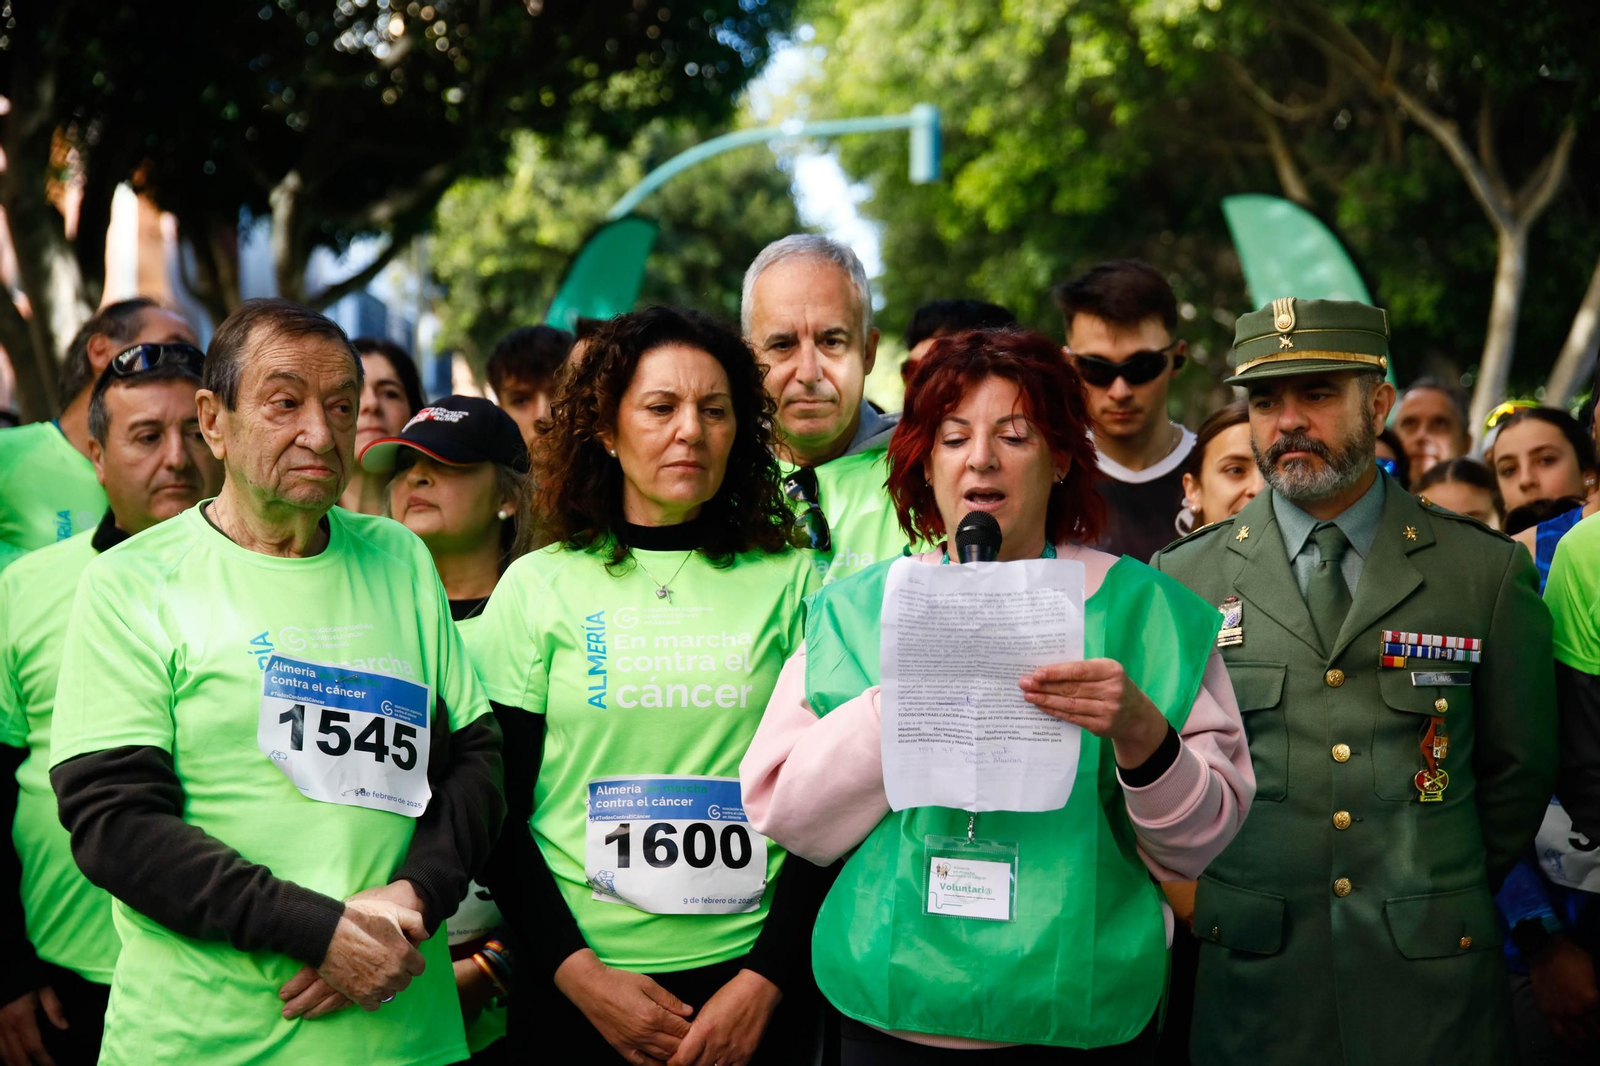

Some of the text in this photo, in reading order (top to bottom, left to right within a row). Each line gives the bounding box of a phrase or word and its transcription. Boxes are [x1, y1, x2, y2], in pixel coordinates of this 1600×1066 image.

[614, 630, 752, 650] En marcha
[271, 660, 316, 678] Almería
[581, 610, 607, 710] ALMERÍA
[616, 648, 752, 672] contra el
[271, 674, 367, 699] contra el cáncer
[616, 676, 752, 709] cáncer
[279, 704, 418, 770] 1545
[360, 789, 371, 797] de
[372, 791, 398, 802] febrero
[406, 800, 423, 808] 2025
[596, 784, 642, 796] Almería
[663, 784, 708, 794] marcha
[596, 797, 694, 809] contra el cáncer
[605, 822, 752, 869] 1600
